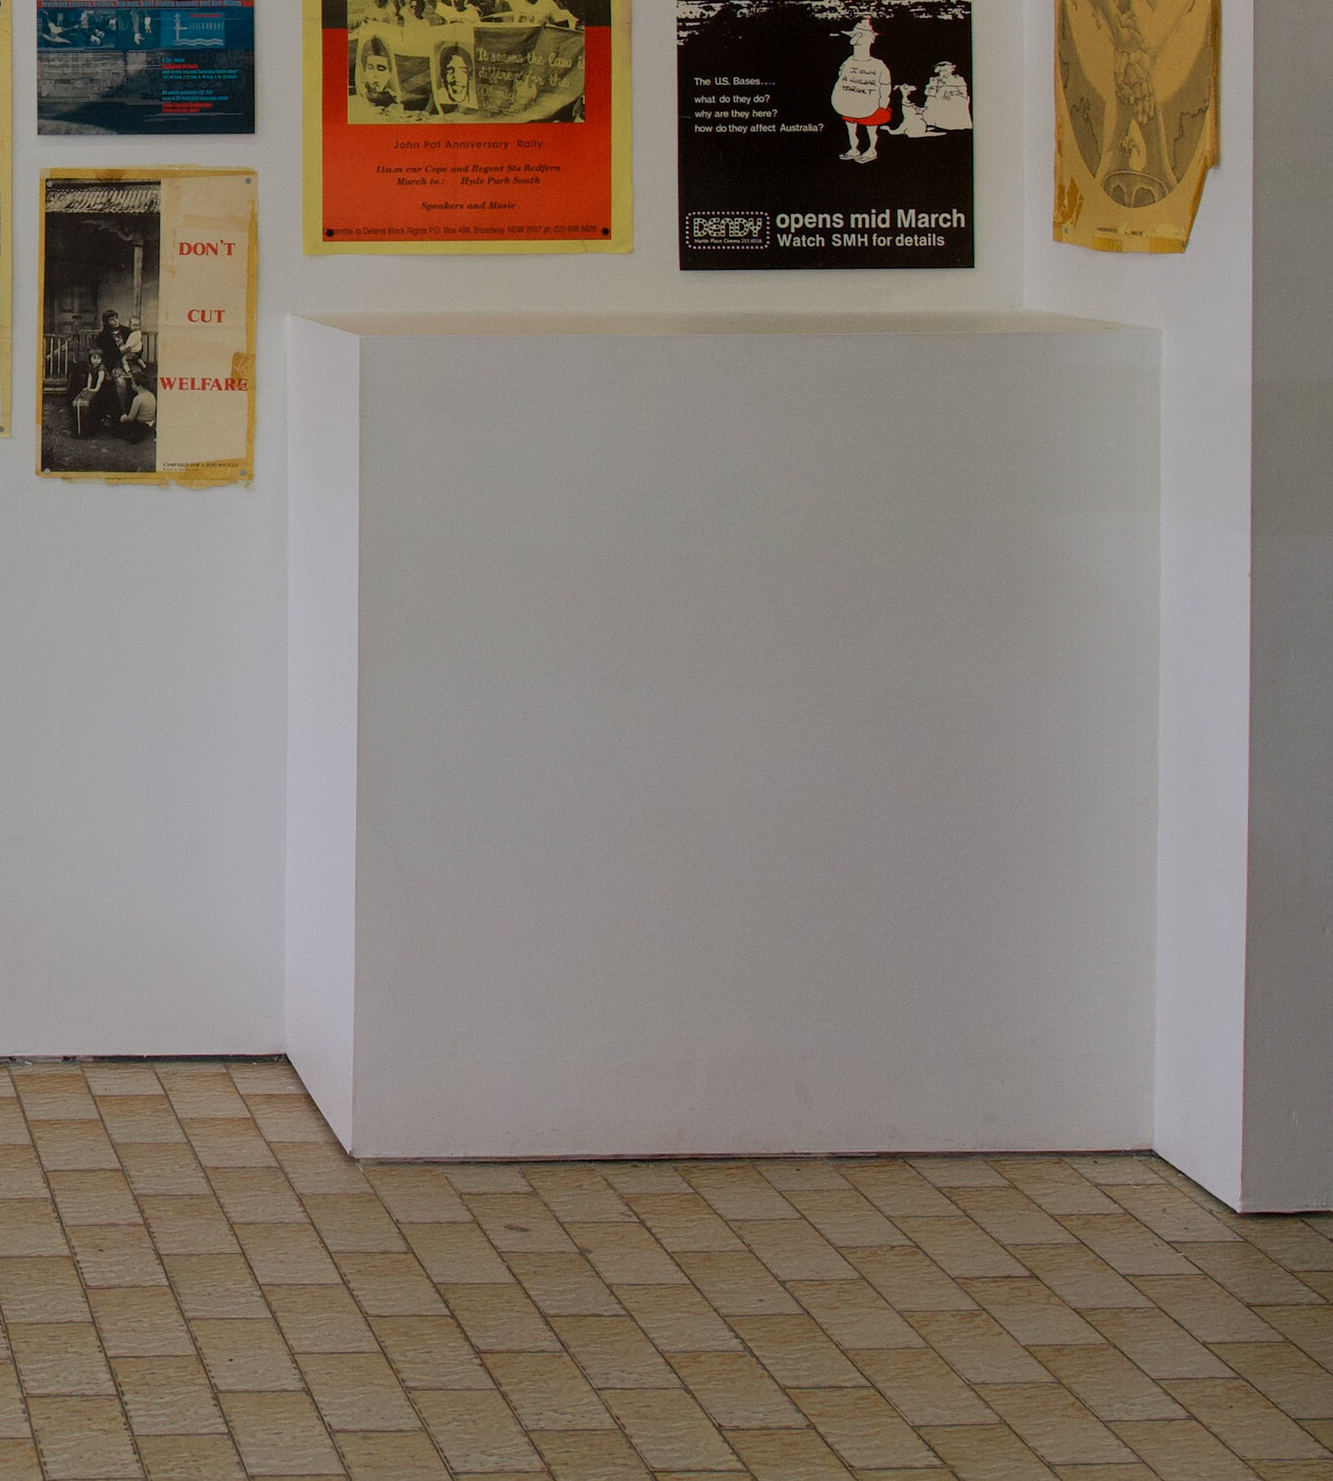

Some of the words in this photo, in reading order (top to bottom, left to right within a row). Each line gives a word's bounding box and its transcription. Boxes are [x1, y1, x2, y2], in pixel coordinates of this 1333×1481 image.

[776, 212, 843, 233] opens
[850, 209, 891, 228] mid
[897, 209, 965, 228] March
[178, 239, 236, 256] DON'T
[187, 310, 225, 323] CUT
[160, 377, 249, 392] WELFARE
